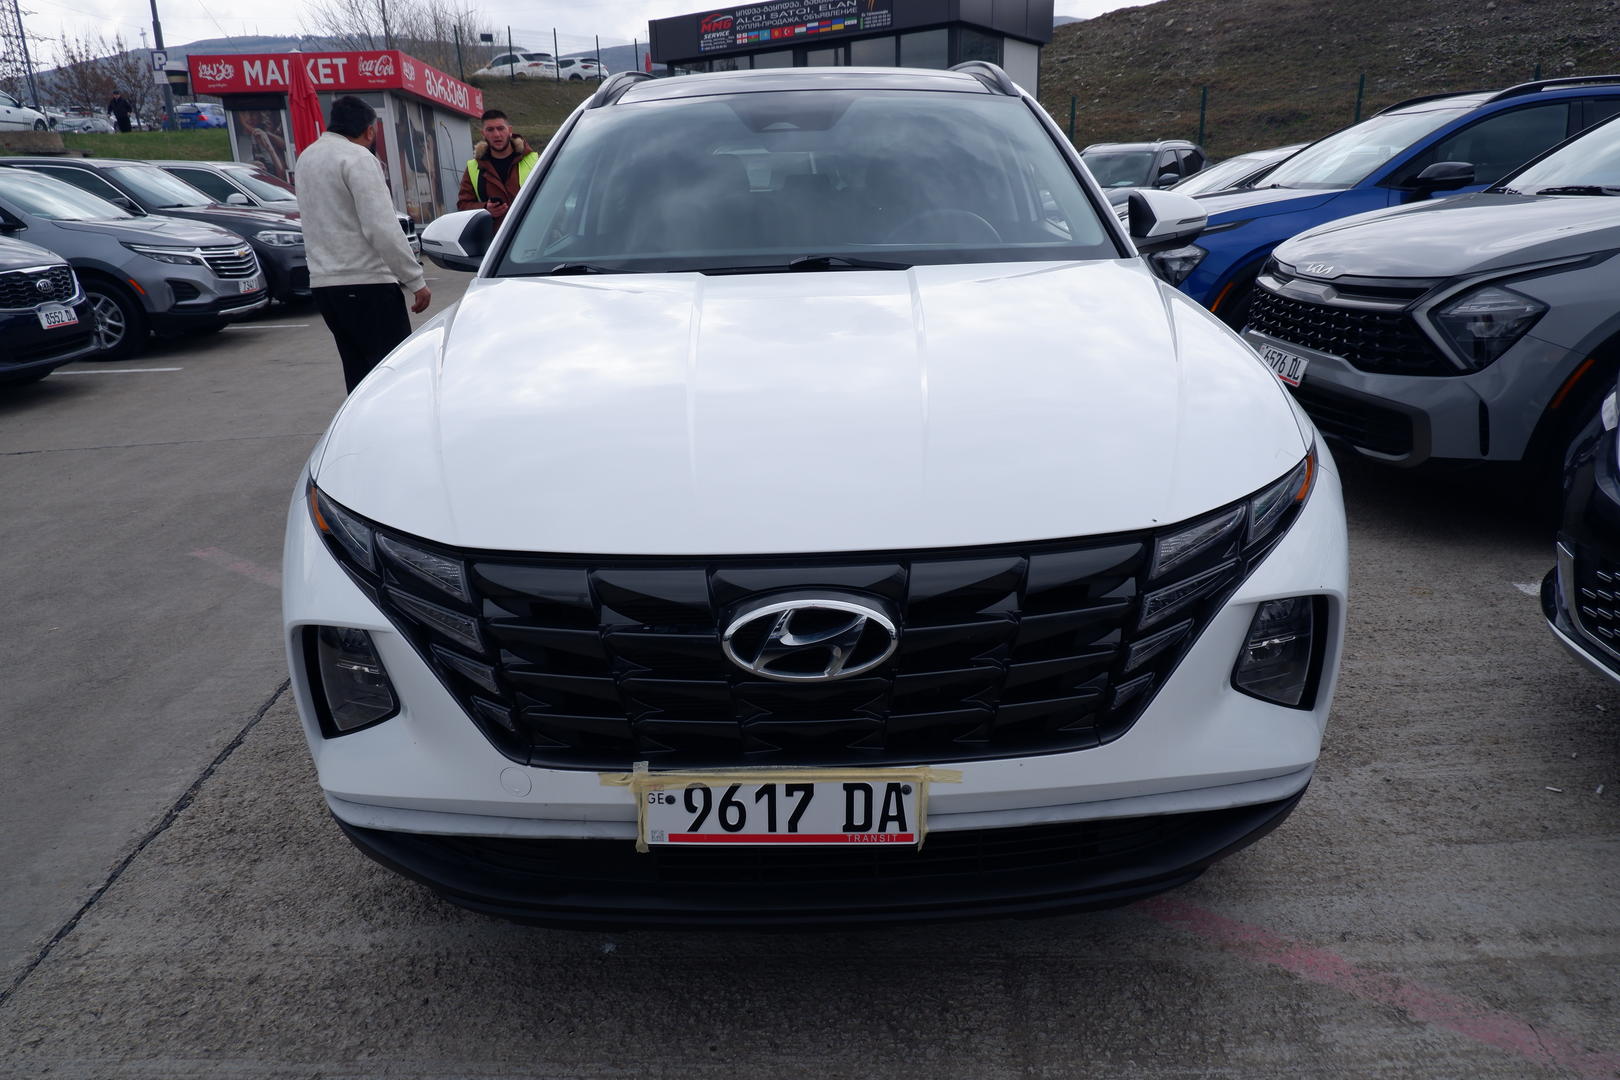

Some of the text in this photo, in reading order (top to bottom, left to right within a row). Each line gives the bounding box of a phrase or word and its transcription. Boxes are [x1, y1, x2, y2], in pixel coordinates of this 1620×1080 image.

[818, 0, 857, 12] ELAN
[703, 30, 730, 41] SERVICE
[153, 52, 167, 70] P
[45, 311, 65, 325] 8552
[1287, 357, 1301, 380] DL
[648, 782, 908, 833] GE 9617 DA
[847, 833, 898, 843] TRANSIT
